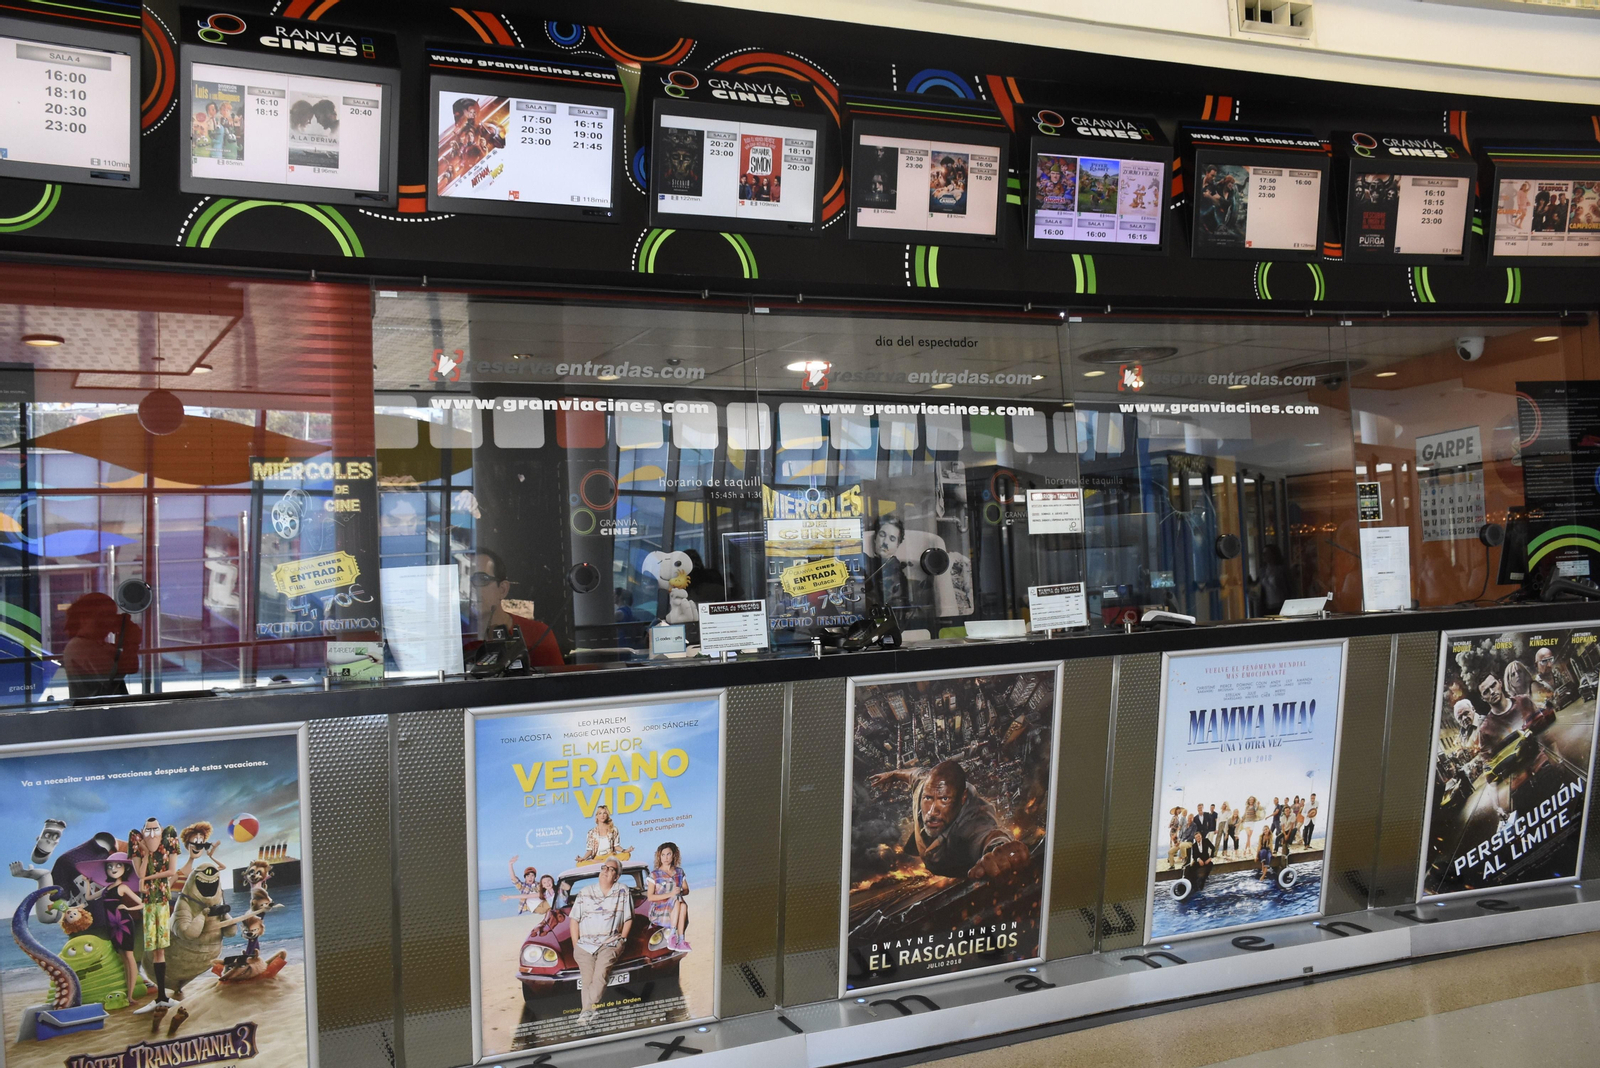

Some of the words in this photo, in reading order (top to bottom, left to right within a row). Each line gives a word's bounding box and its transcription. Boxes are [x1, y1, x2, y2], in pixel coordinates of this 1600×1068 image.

[260, 35, 358, 57] CINES
[49, 53, 73, 62] SALA
[45, 69, 87, 84] 16:00
[45, 86, 87, 101] 18:10
[708, 79, 787, 96] GRANVÍA
[256, 98, 279, 107] 16:10
[712, 89, 790, 106] CINES
[45, 102, 87, 117] 20:30
[256, 108, 279, 117] 18:15
[350, 108, 372, 117] 20:40
[522, 115, 552, 124] 17:50
[574, 120, 604, 130] 16:15
[1071, 116, 1138, 131] GRANVÍA
[45, 119, 87, 134] 23:00
[521, 126, 552, 135] 20:30
[573, 131, 603, 140] 19:00
[1076, 127, 1142, 140] CINES
[310, 136, 338, 144] DERIVA
[520, 137, 551, 146] 23:00
[573, 141, 603, 151] 21:45
[710, 140, 734, 148] 20:20
[1382, 138, 1442, 150] GRANVÍA
[710, 149, 734, 157] 23:00
[788, 148, 811, 156] 18:10
[1388, 147, 1448, 159] CINES
[787, 164, 810, 172] 20:30
[1422, 208, 1443, 216] 20:40
[1421, 217, 1442, 225] 23:00
[1359, 236, 1385, 246] PURGA
[900, 336, 914, 347] del
[918, 337, 978, 349] espectador
[430, 397, 710, 414] www.granviacines.com
[1119, 401, 1319, 415] www.granviacines.com
[1422, 436, 1474, 462] GARPE
[252, 458, 374, 480] MIÉRCOLES
[1044, 476, 1077, 485] horario
[1080, 476, 1090, 485] de
[1092, 476, 1124, 488] taquilla
[334, 484, 350, 495] DE
[324, 499, 361, 512] CINE
[762, 483, 862, 520] MIÉRCOLES
[600, 517, 638, 527] GRANVÍA
[802, 520, 828, 528] DE
[600, 527, 638, 536] CINES
[778, 527, 852, 540] CINE
[289, 565, 344, 583] ENTRADA
[793, 568, 837, 585] ENTRADA
[289, 583, 306, 592] Fila:
[314, 576, 344, 586] Butaca:
[792, 584, 807, 592] Fila:
[812, 578, 837, 588] Butaca:
[1494, 642, 1513, 650] JONES
[1529, 638, 1559, 647] KINGSLEY
[1571, 636, 1597, 644] HOPKINS
[1204, 666, 1230, 674] VUELVE
[1242, 662, 1276, 671] FENÓMENO
[1279, 660, 1307, 668] MUNDIAL
[1242, 669, 1286, 678] EMOCIONANTE
[8, 684, 36, 693] gracias!
[592, 716, 627, 726] HARLEM
[642, 724, 661, 732] JORDI
[662, 719, 699, 730] SÁNCHEZ
[1188, 704, 1267, 746] MAMMA
[1270, 698, 1316, 738] MIA!
[518, 733, 552, 743] ACOSTA
[563, 730, 589, 738] MAGGIE
[590, 726, 631, 736] CIVANTOS
[562, 743, 582, 757] EL
[586, 737, 643, 754] MEJOR
[1220, 742, 1236, 753] UNA
[1238, 742, 1243, 751] Y
[1244, 740, 1266, 750] OTRA
[1268, 738, 1283, 748] VEZ
[1228, 756, 1252, 766] JULIO
[1255, 754, 1272, 764] 2018
[44, 775, 83, 786] necesitar
[84, 774, 106, 782] unas
[107, 769, 152, 780] vacaciones
[154, 765, 188, 777] después
[189, 764, 200, 773] de
[201, 763, 222, 771] estas
[224, 759, 269, 770] vacaciones.
[511, 748, 690, 793] VERANO
[524, 792, 547, 808] DE
[552, 790, 570, 804] MI
[572, 780, 672, 818] VIDA
[643, 816, 674, 827] promesas
[676, 812, 693, 820] están
[638, 826, 652, 834] para
[654, 822, 685, 833] cumplirse
[1454, 776, 1584, 877] PERSECUCIÓN
[536, 828, 563, 838] MÁLAGA
[1482, 855, 1506, 880] AL
[1510, 807, 1570, 860] LÍMITE
[872, 934, 935, 952] DWAYNE
[948, 921, 1018, 940] JOHNSON
[869, 953, 892, 971] EL
[899, 932, 1018, 966] RASCACIELOS
[926, 961, 944, 970] JULIO
[946, 958, 962, 967] 2018
[592, 1002, 605, 1010] Dani
[622, 996, 642, 1005] Orden
[130, 1033, 233, 1068] TRANSILVANIA
[236, 1025, 252, 1058] 3
